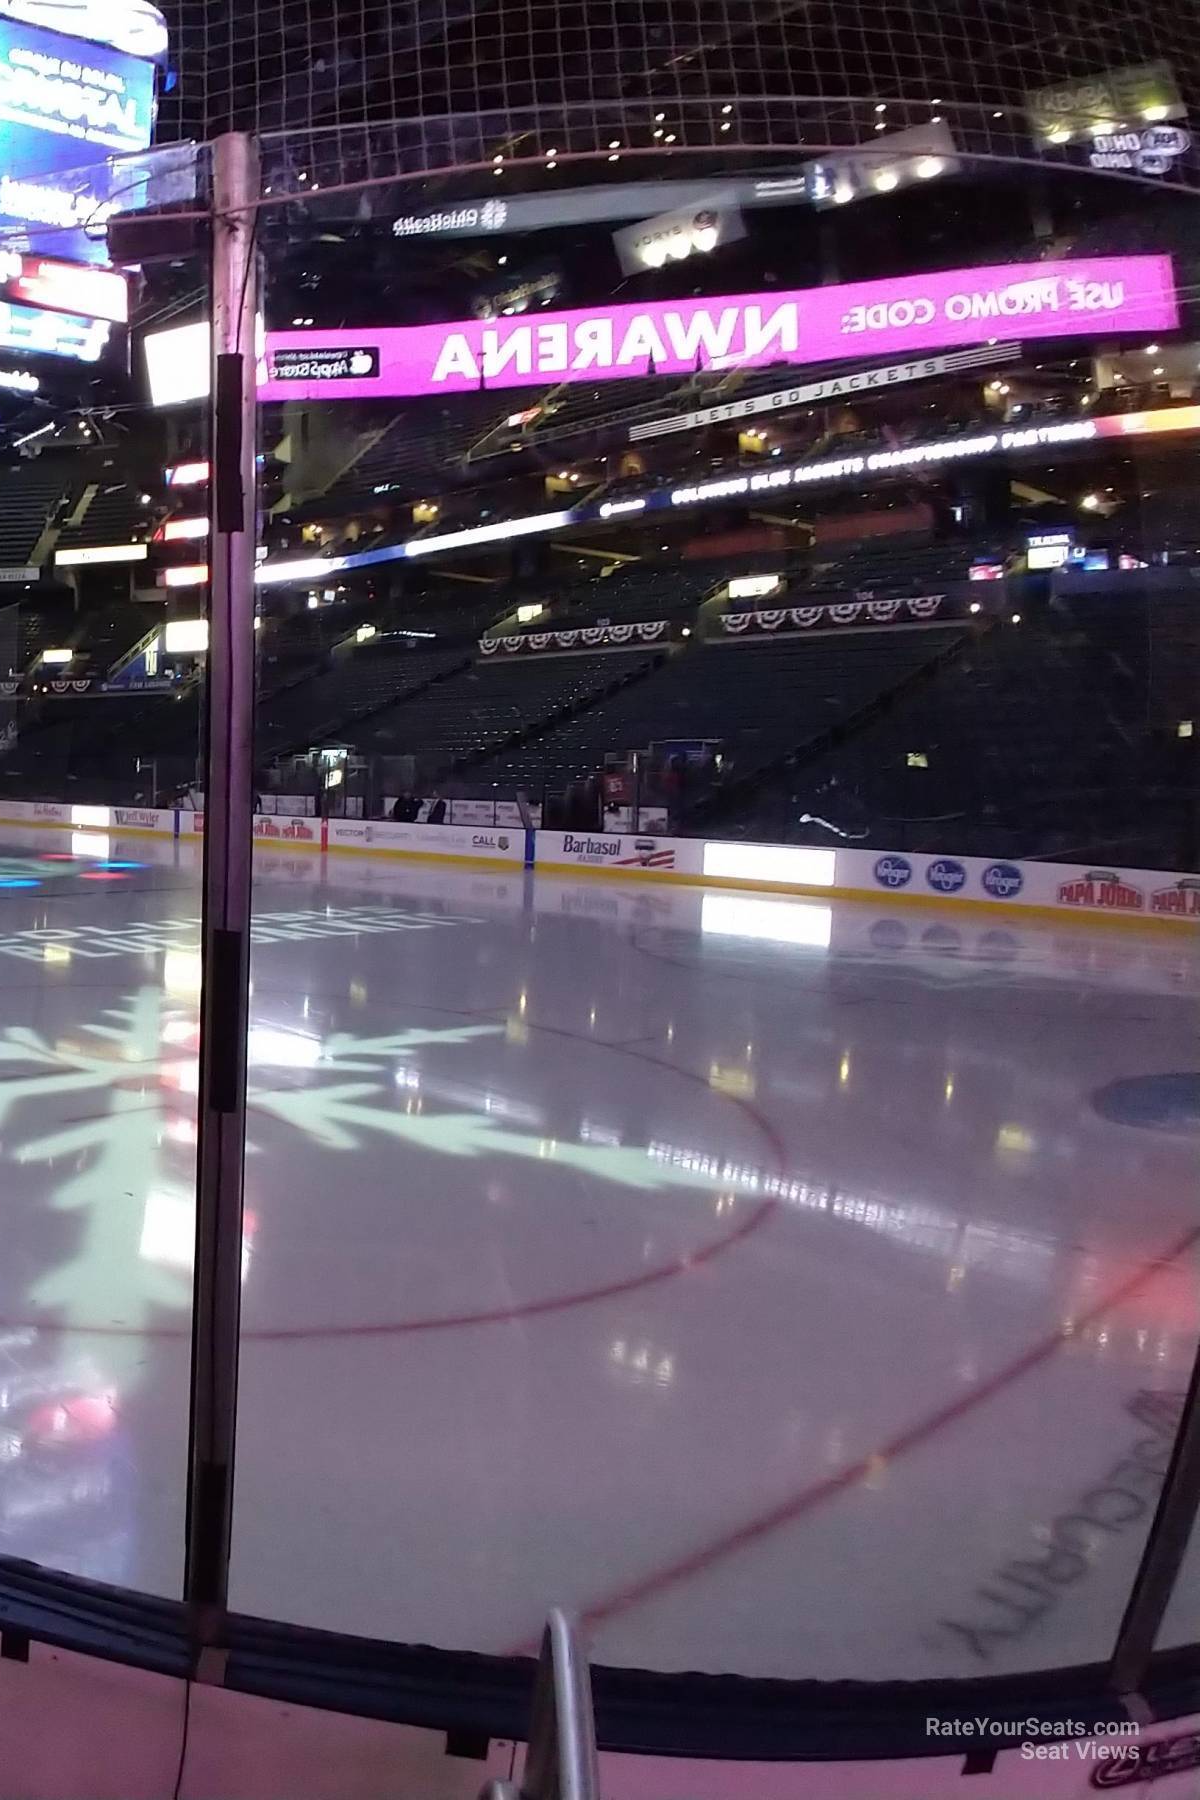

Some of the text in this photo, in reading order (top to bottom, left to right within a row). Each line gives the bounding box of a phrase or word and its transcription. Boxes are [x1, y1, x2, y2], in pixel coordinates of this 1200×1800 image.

[772, 390, 800, 407] GO
[814, 361, 937, 397] JACKETS
[335, 828, 364, 838] VECTOR
[471, 835, 497, 847] CALL
[563, 834, 622, 857] Barbasol
[877, 859, 910, 885] Kroger
[930, 863, 964, 890] Kroger
[985, 867, 1020, 895] Kroger
[1059, 881, 1094, 903] PAPA
